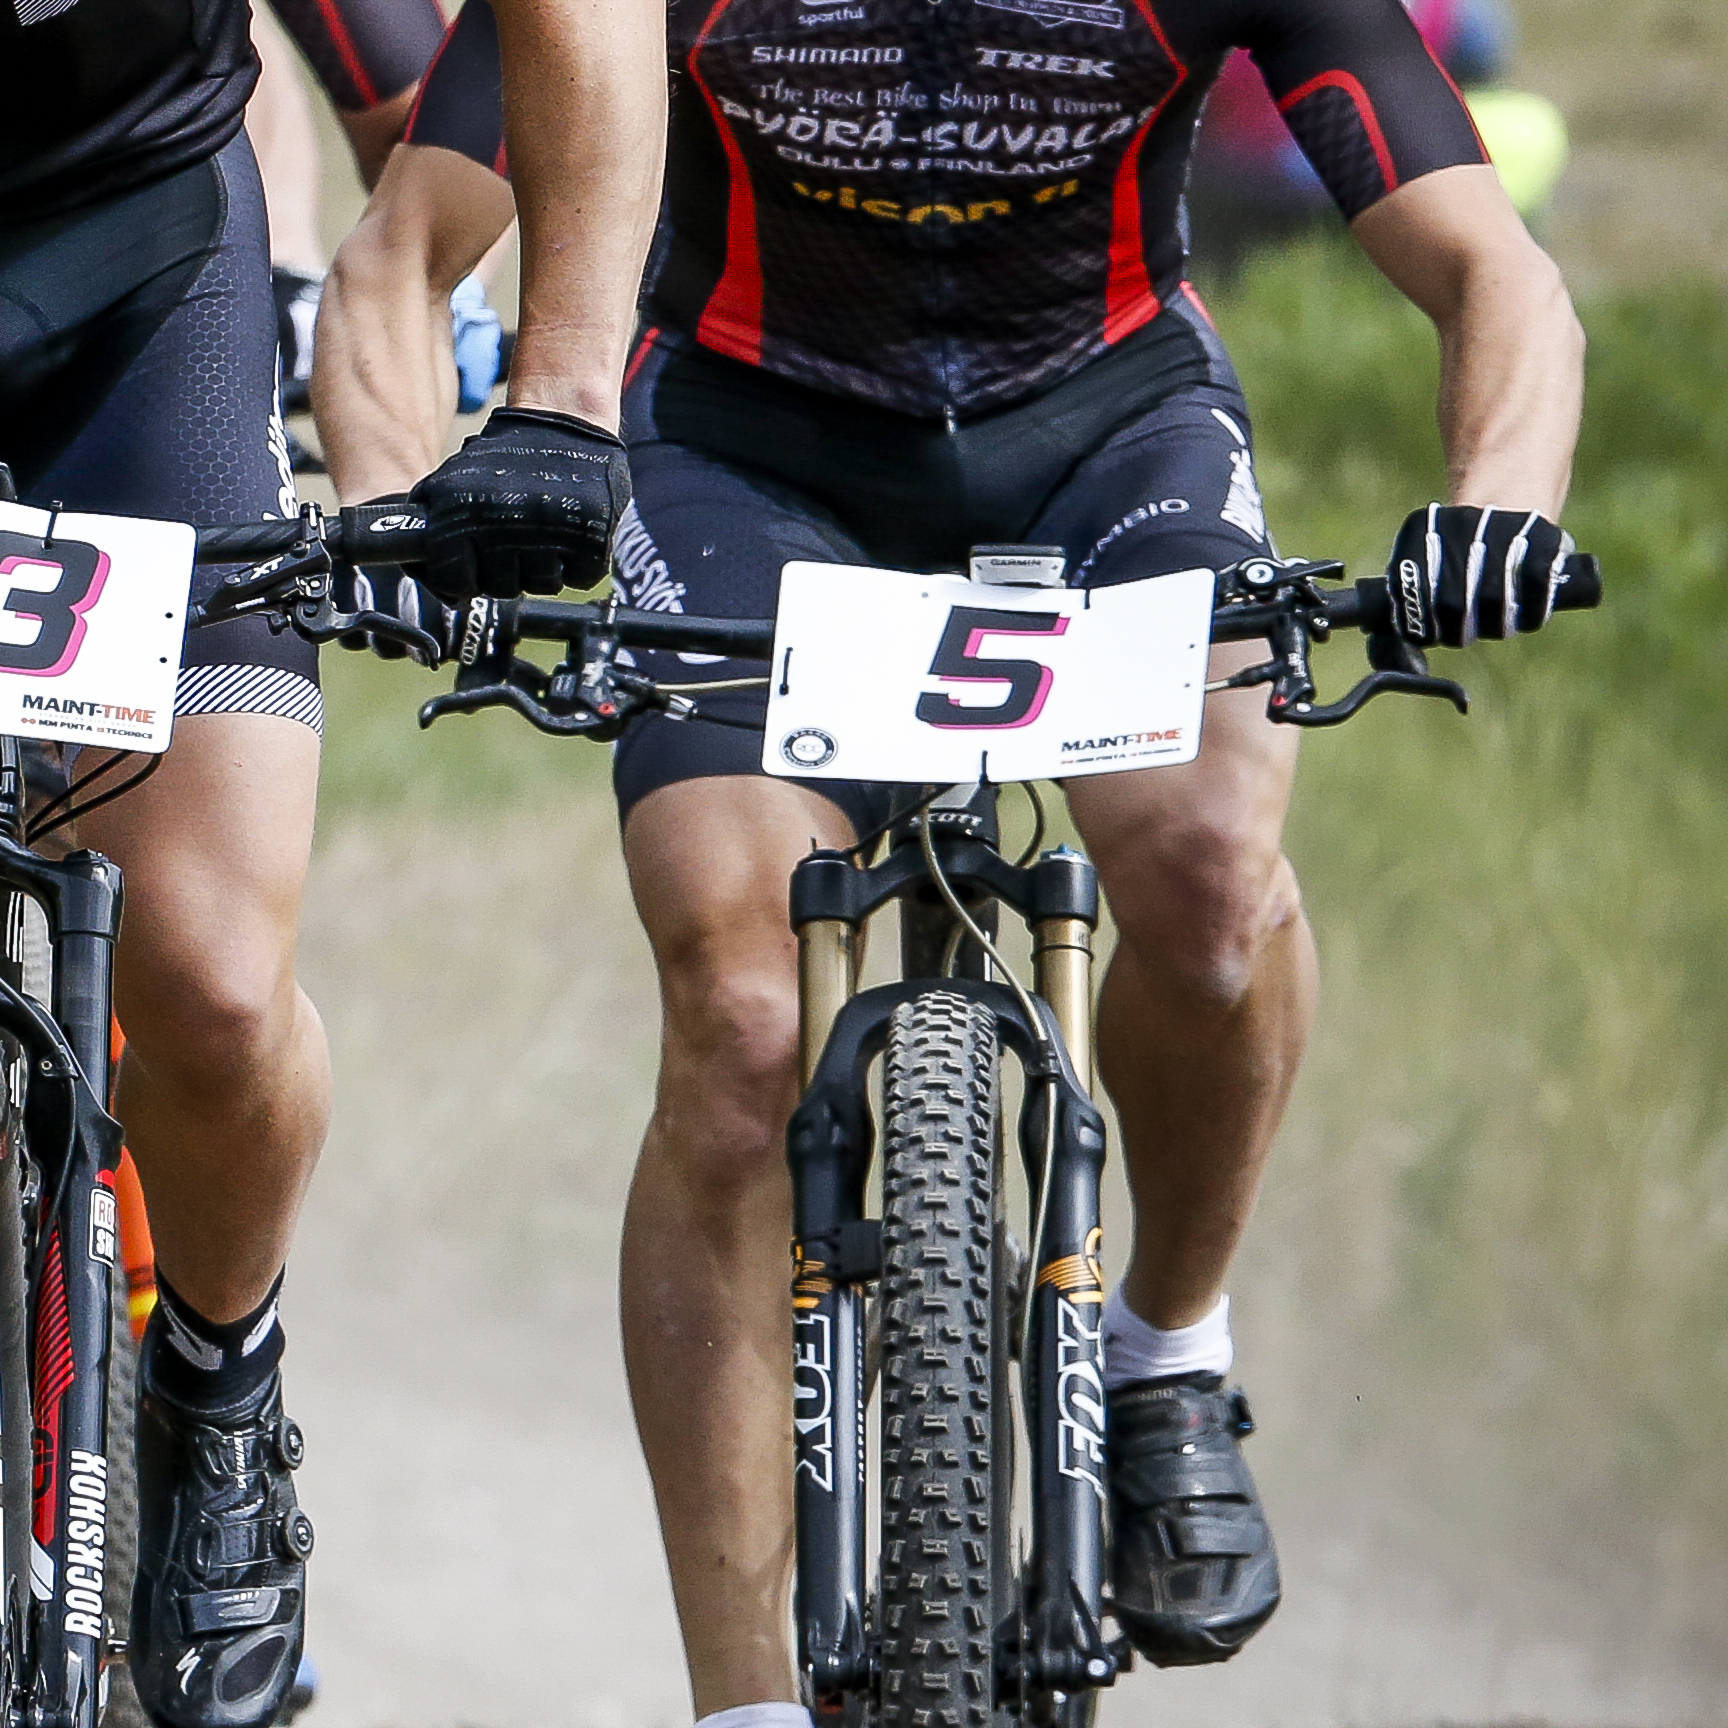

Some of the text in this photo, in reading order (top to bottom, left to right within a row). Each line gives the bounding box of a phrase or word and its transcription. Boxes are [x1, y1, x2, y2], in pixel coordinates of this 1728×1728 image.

[798, 6, 865, 26] sportful
[751, 45, 905, 64] SHIMANO
[975, 47, 1115, 78] TREK
[777, 145, 1094, 175] OULU FINLAND
[249, 556, 285, 581] XT
[916, 605, 1076, 731] 5
[22, 694, 157, 725] MAINT-TIME
[793, 1312, 833, 1493] FOX
[64, 1449, 108, 1640] ROCKSHOX
